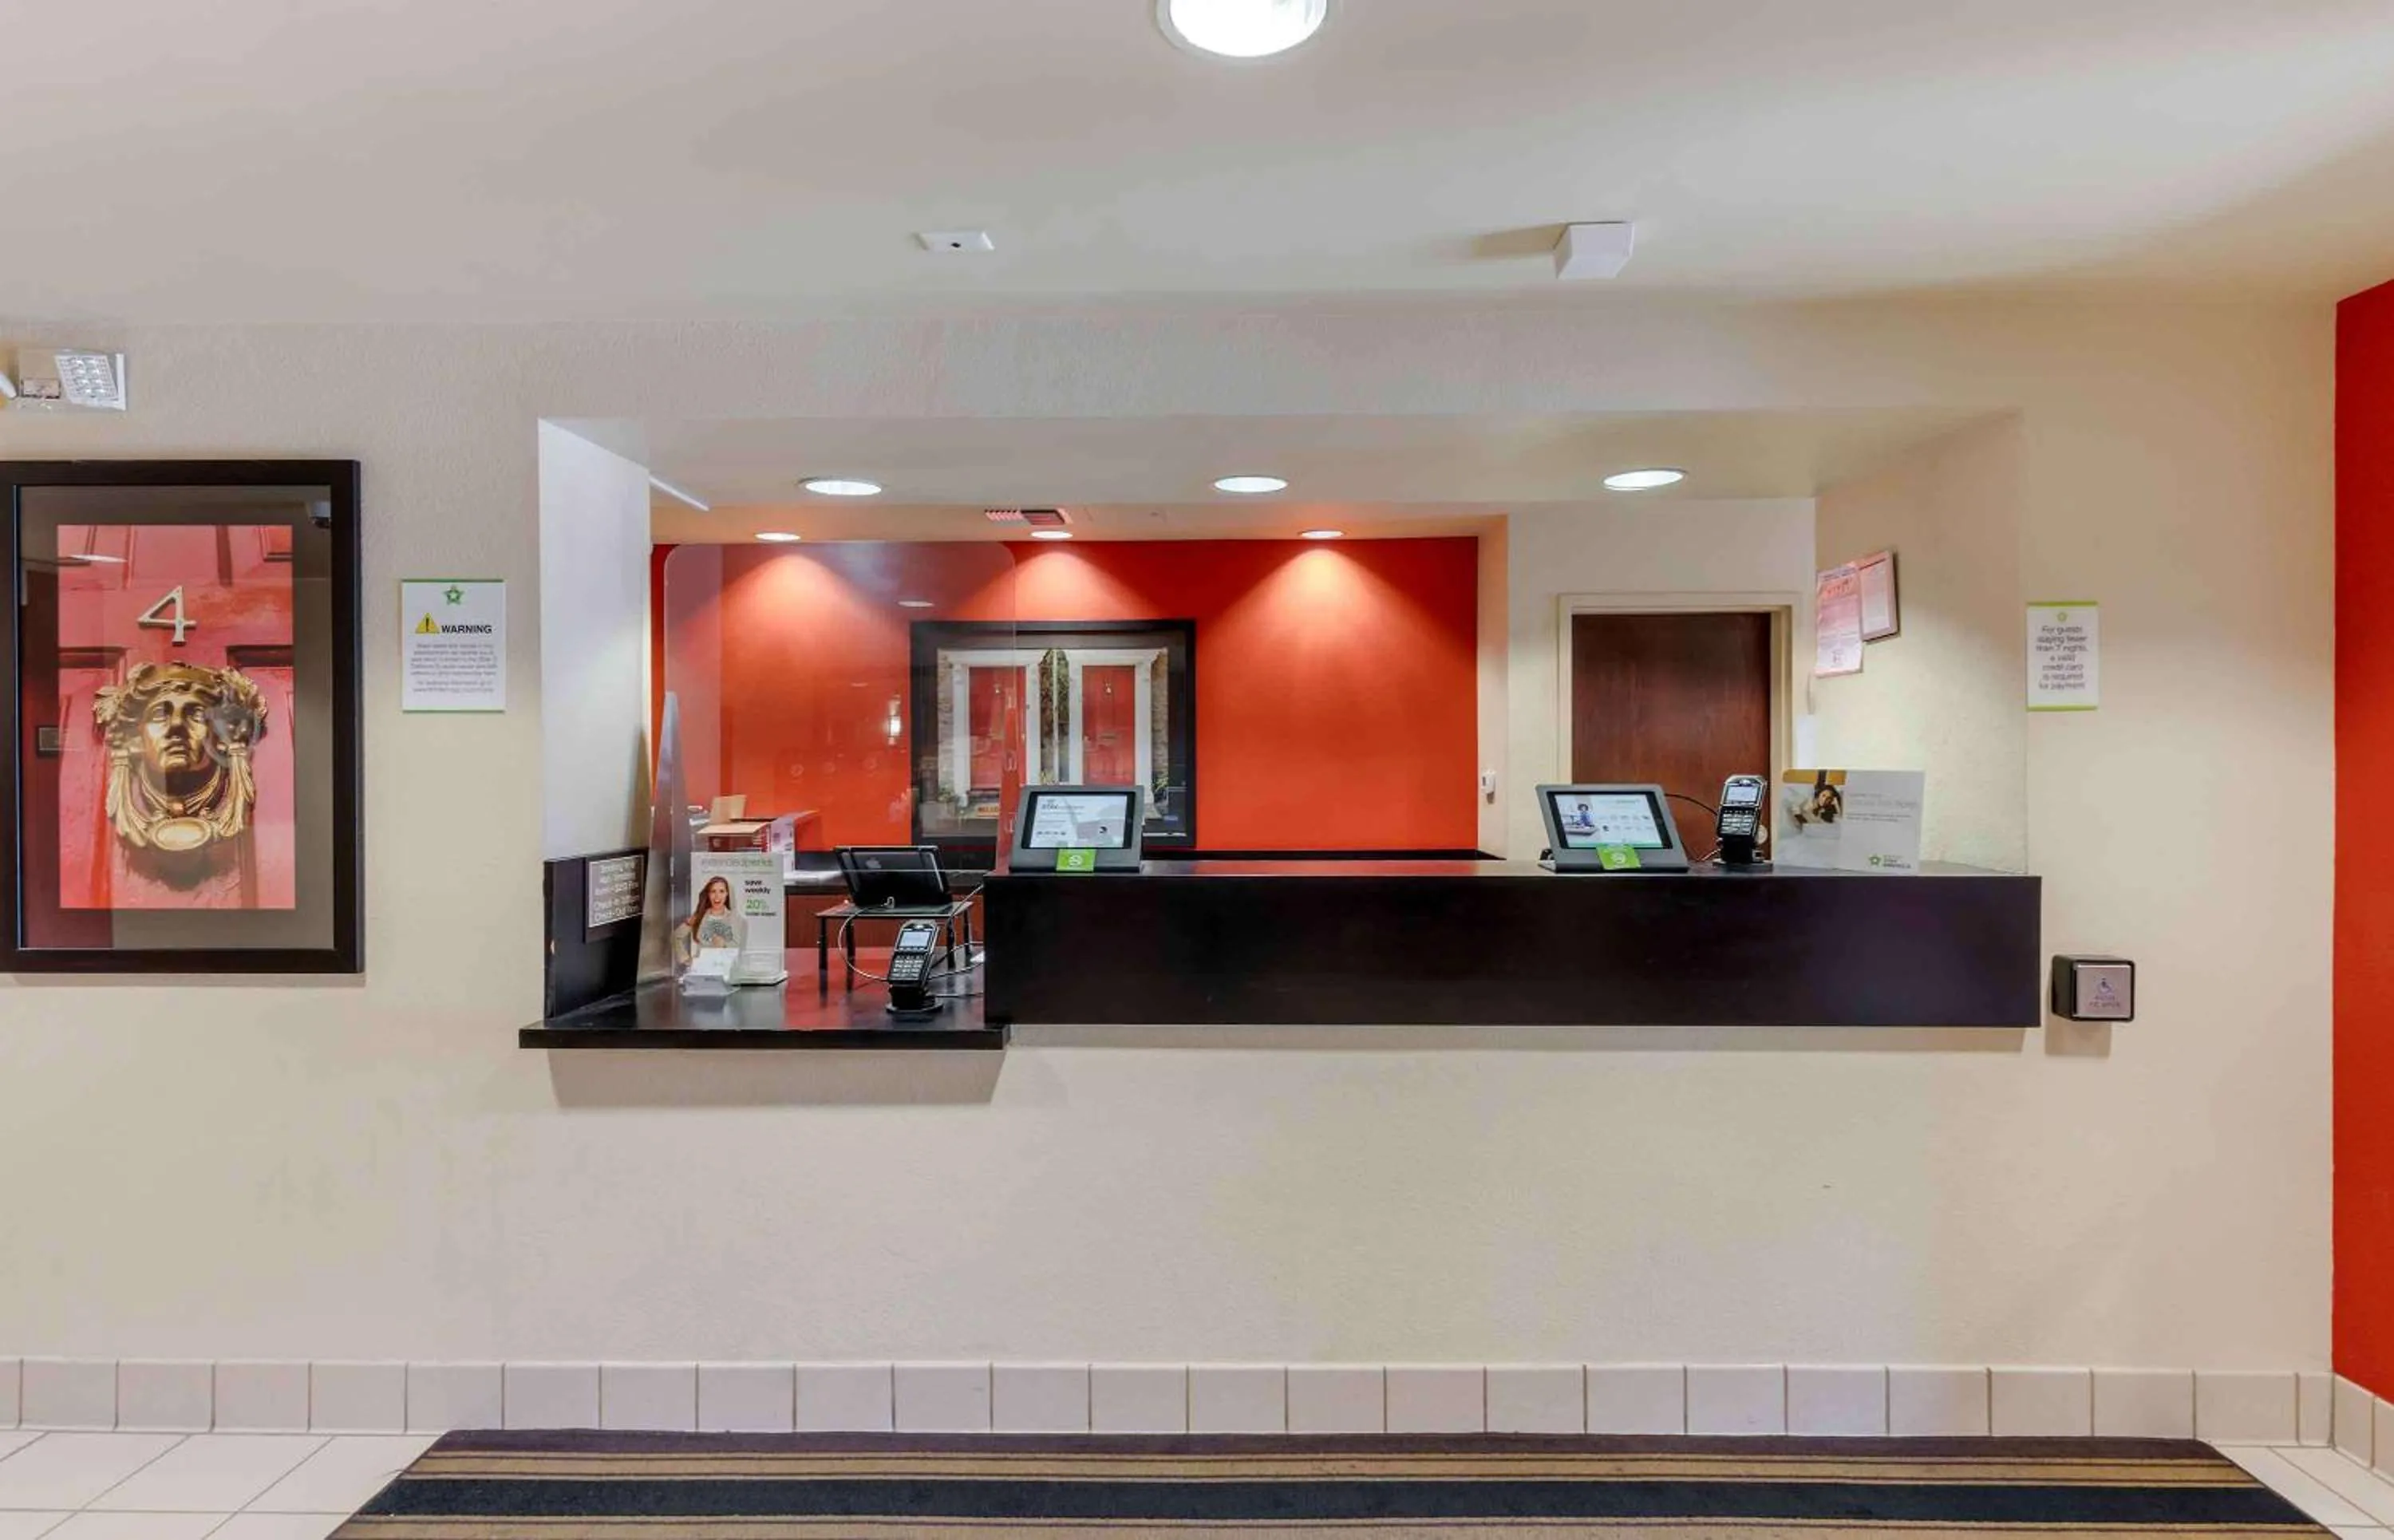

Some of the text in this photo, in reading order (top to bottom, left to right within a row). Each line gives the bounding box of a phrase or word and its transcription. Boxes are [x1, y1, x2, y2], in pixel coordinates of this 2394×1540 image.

[138, 586, 197, 646] 4
[440, 625, 492, 634] WARNING
[2056, 626, 2082, 635] guests
[2051, 673, 2084, 681] required
[2050, 682, 2085, 691] payment
